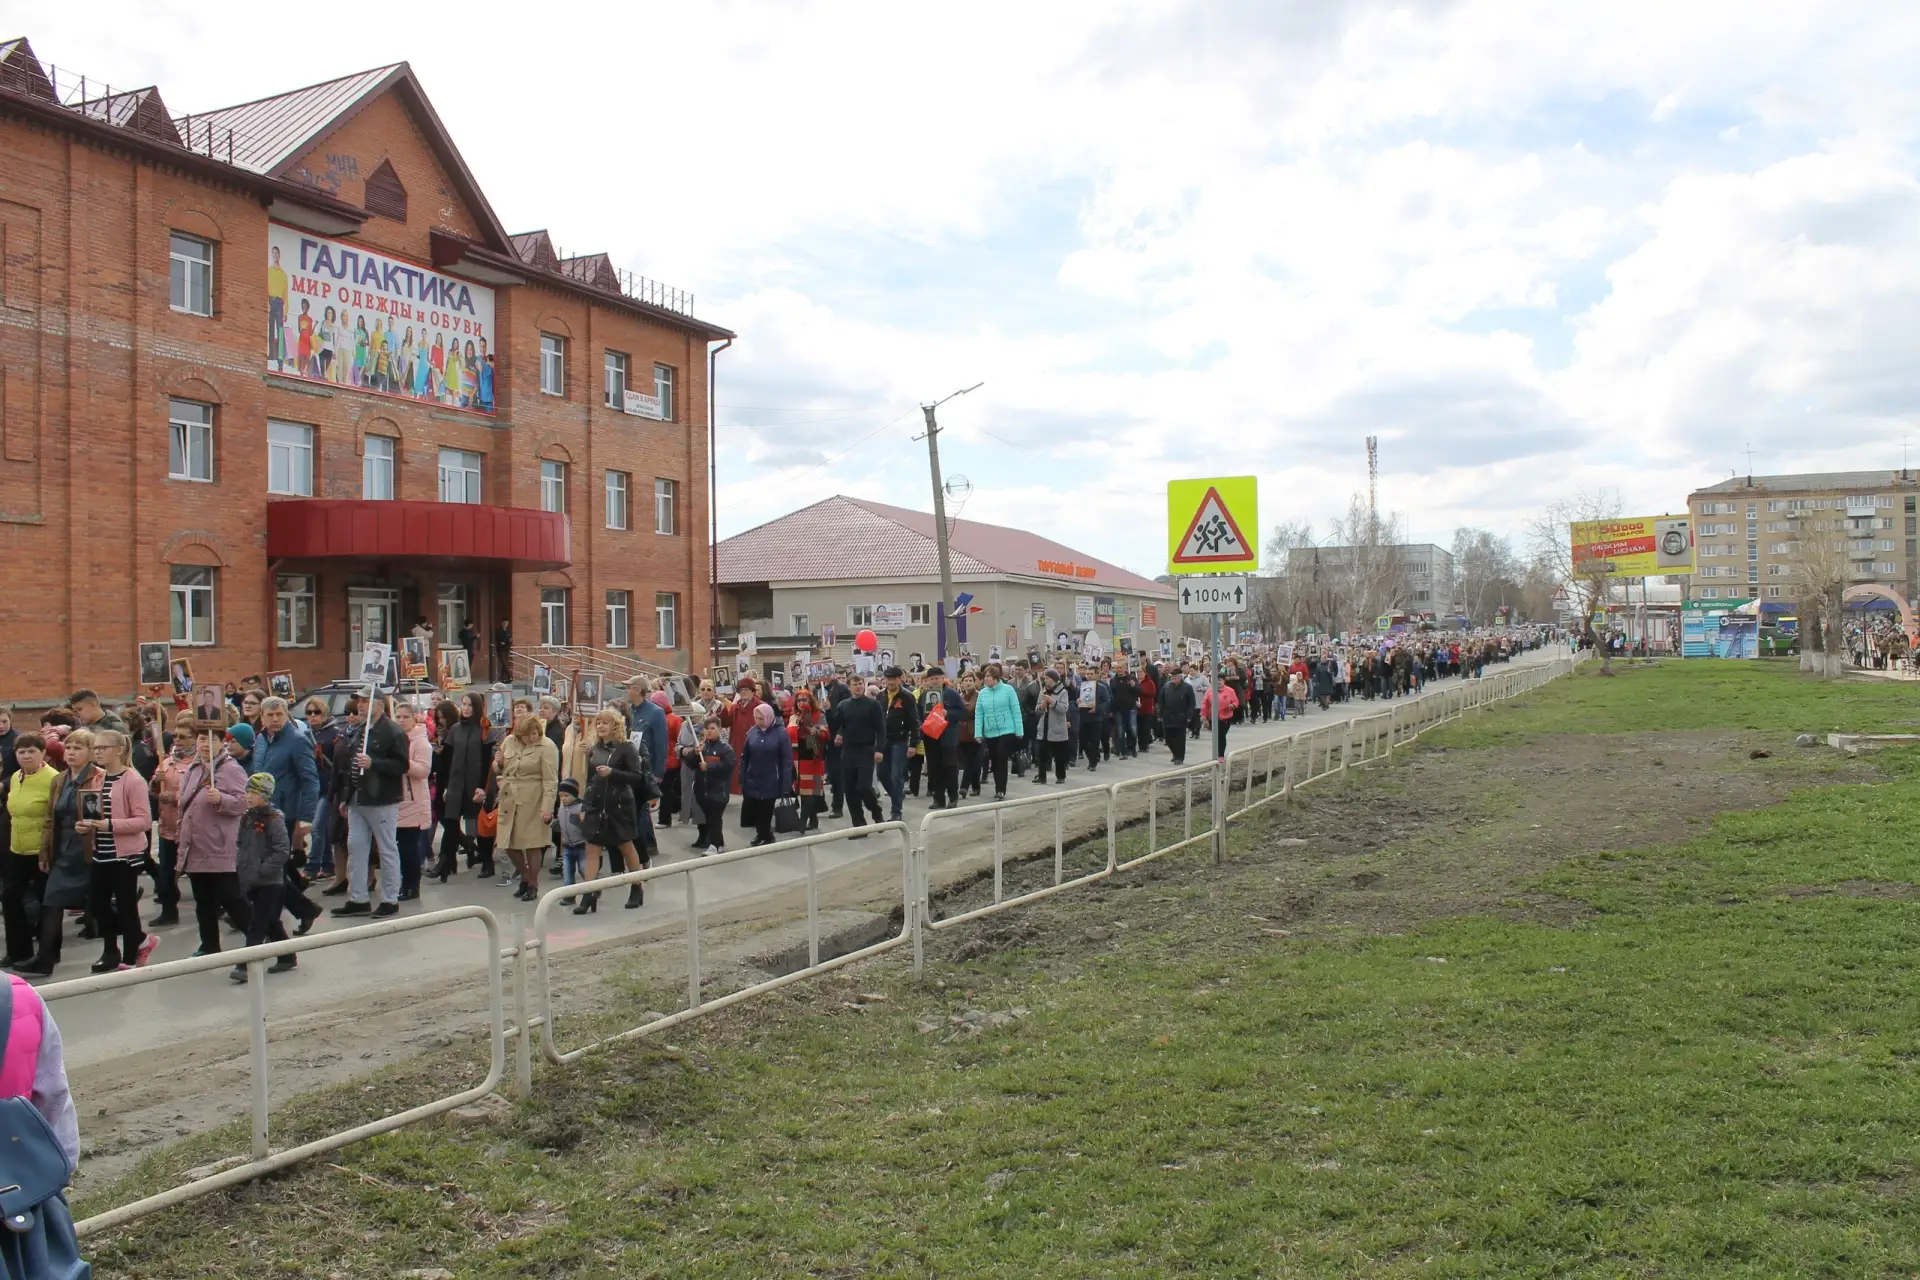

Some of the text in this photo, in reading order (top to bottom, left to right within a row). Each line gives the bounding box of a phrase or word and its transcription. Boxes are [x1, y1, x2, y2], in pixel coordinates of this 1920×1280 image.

[291, 275, 332, 299] МИР
[338, 286, 412, 320] ОДЕЖДЫ
[430, 310, 483, 337] ОБУВИ
[300, 238, 476, 315] ГАЛАКТИКА
